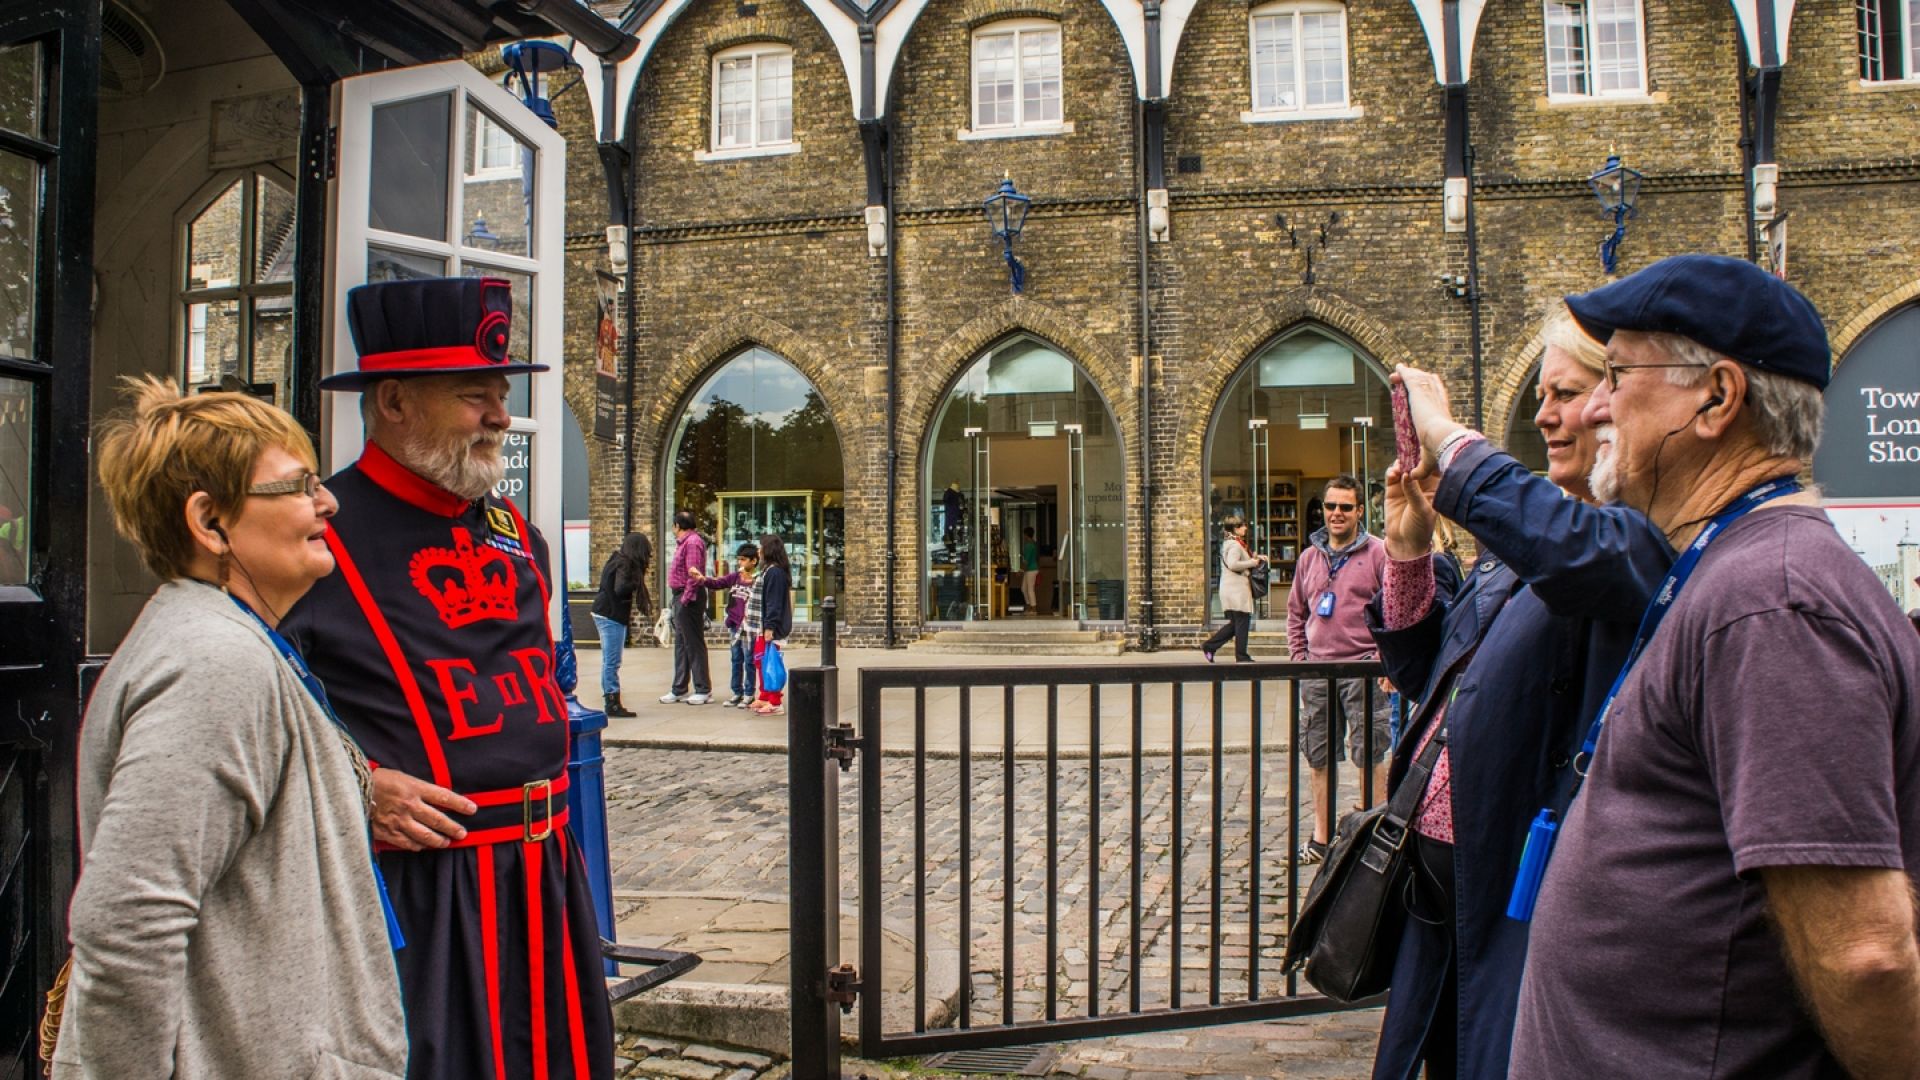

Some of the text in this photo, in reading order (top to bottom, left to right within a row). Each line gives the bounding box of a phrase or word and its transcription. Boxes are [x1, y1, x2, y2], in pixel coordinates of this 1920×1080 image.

[1860, 387, 1920, 409] Tow
[1866, 415, 1920, 436] Lon
[1868, 440, 1920, 463] Sho
